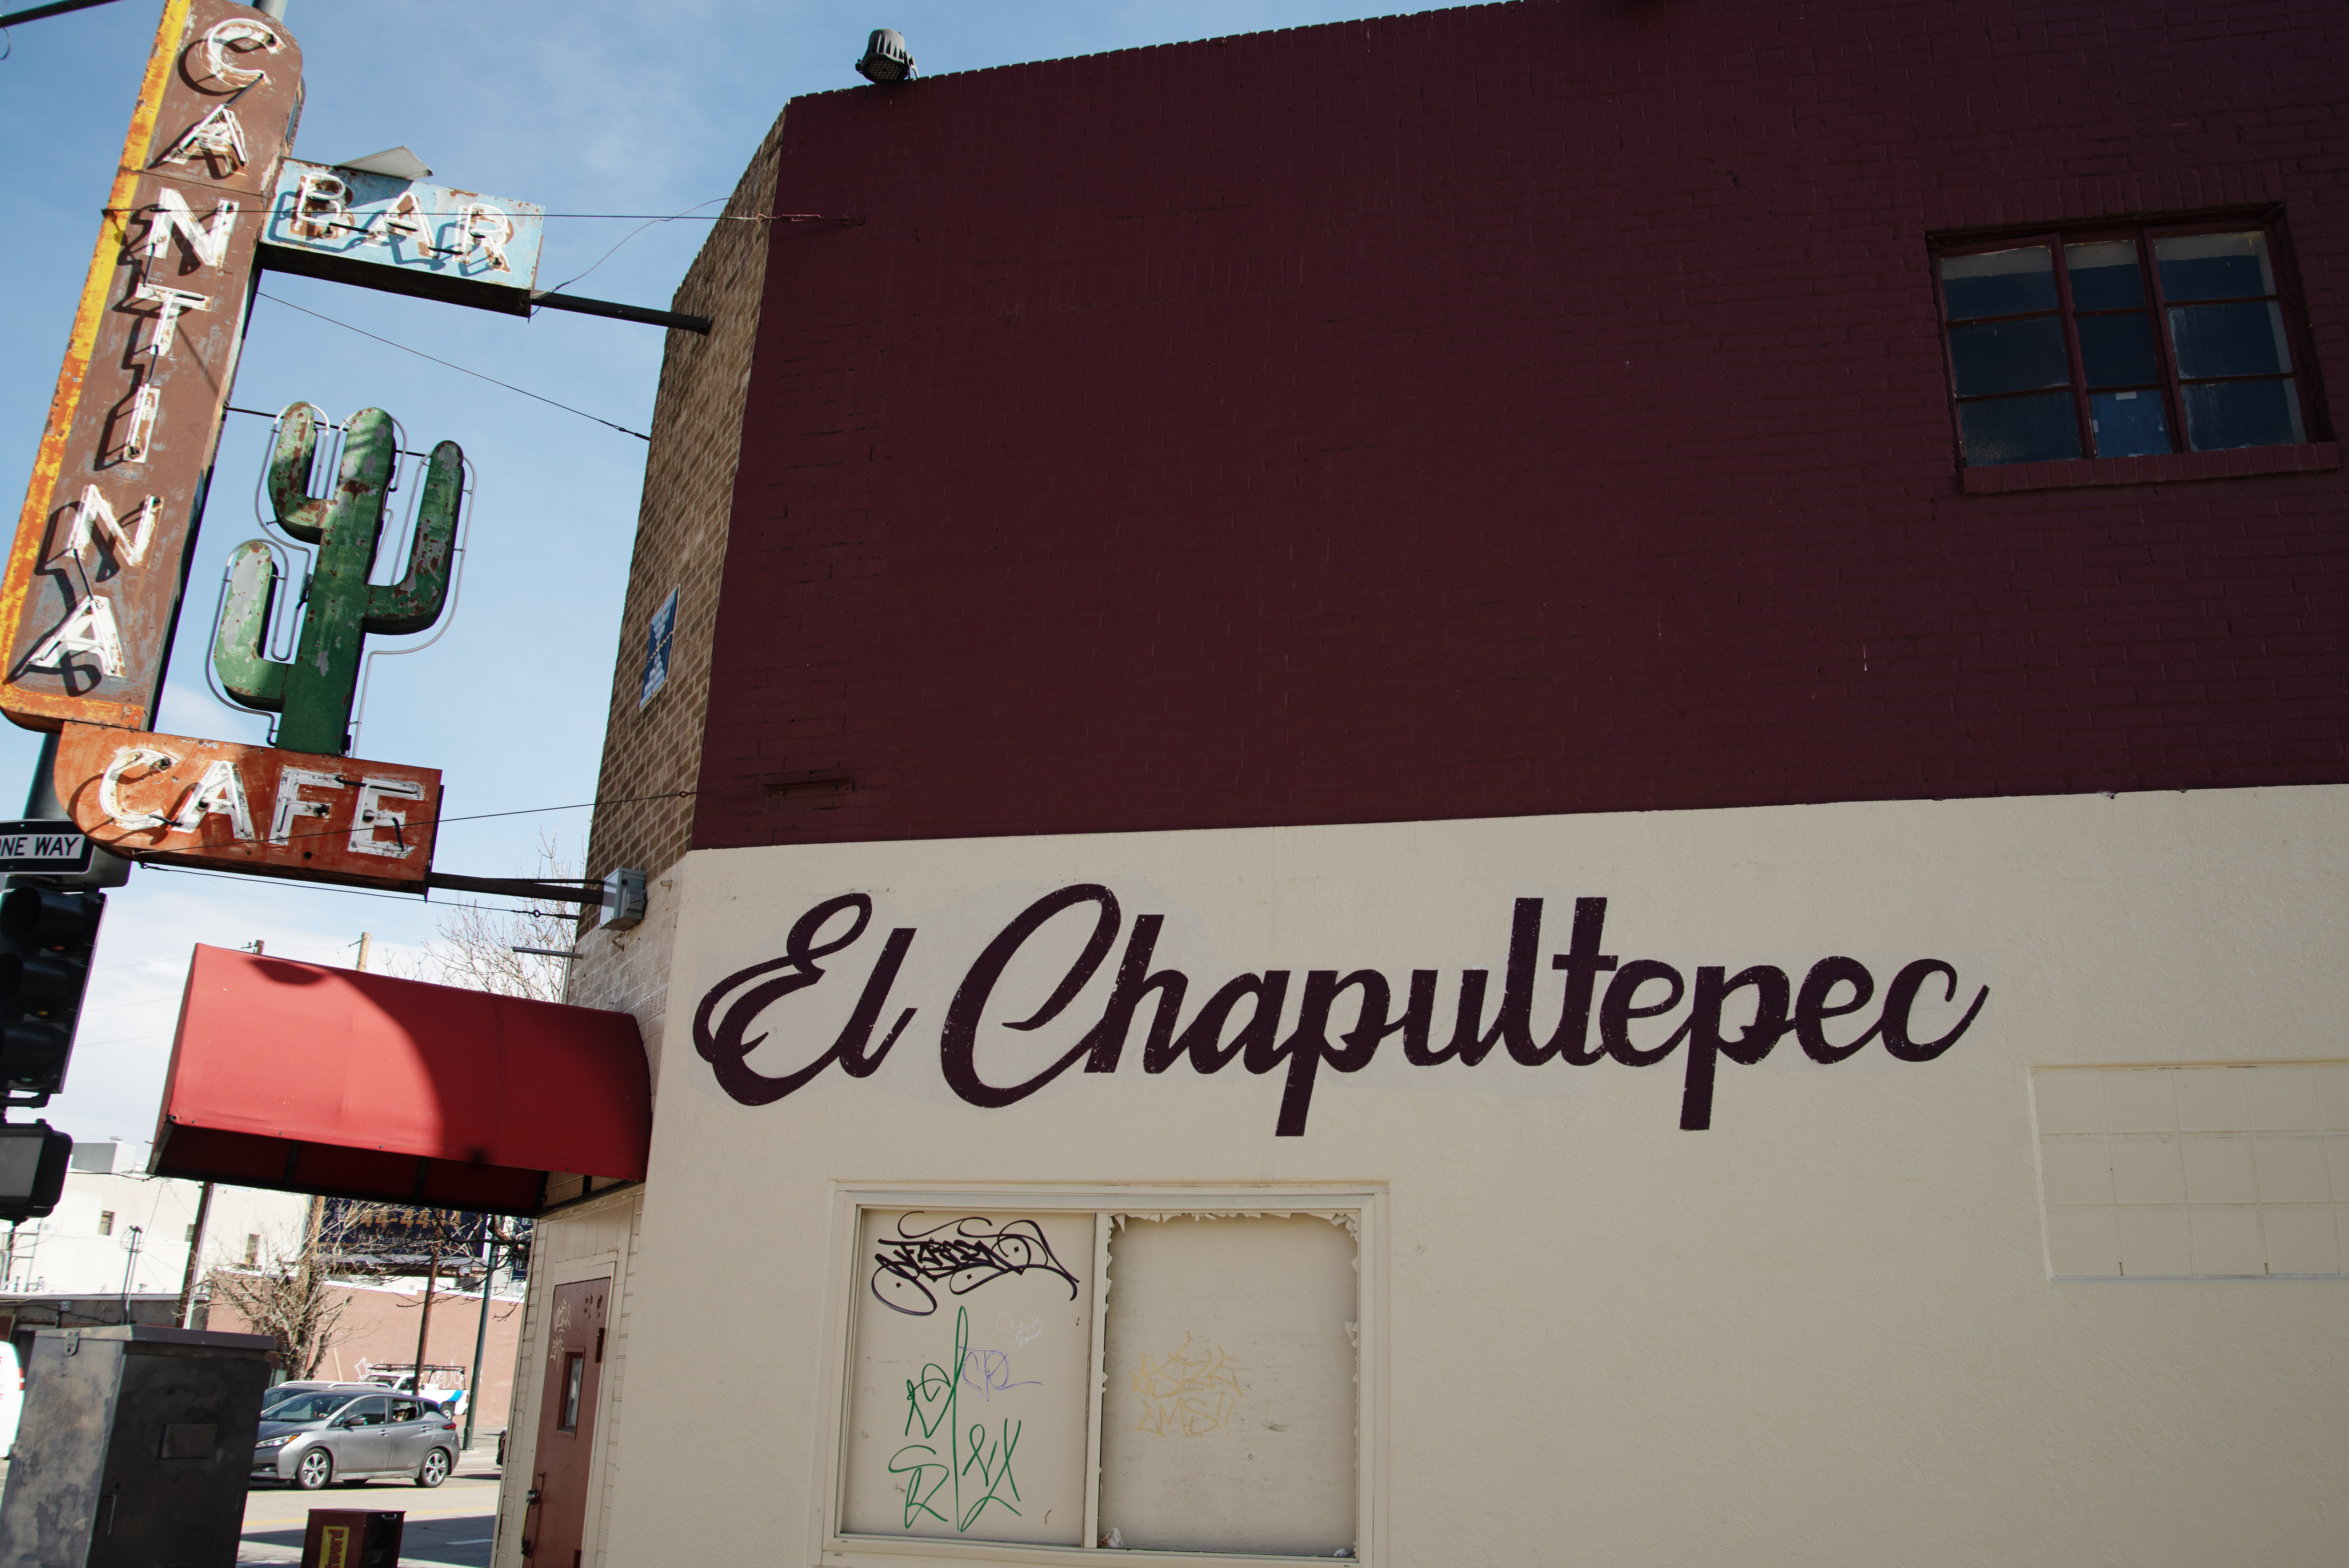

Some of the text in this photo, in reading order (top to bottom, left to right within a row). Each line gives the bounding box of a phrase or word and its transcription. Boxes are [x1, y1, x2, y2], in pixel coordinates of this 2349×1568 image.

[289, 172, 514, 273] BAR
[26, 17, 286, 678] CANTINA
[0, 837, 79, 856] NE WAY
[99, 747, 424, 859] CAFE
[692, 884, 1990, 1137] El Chapultepec
